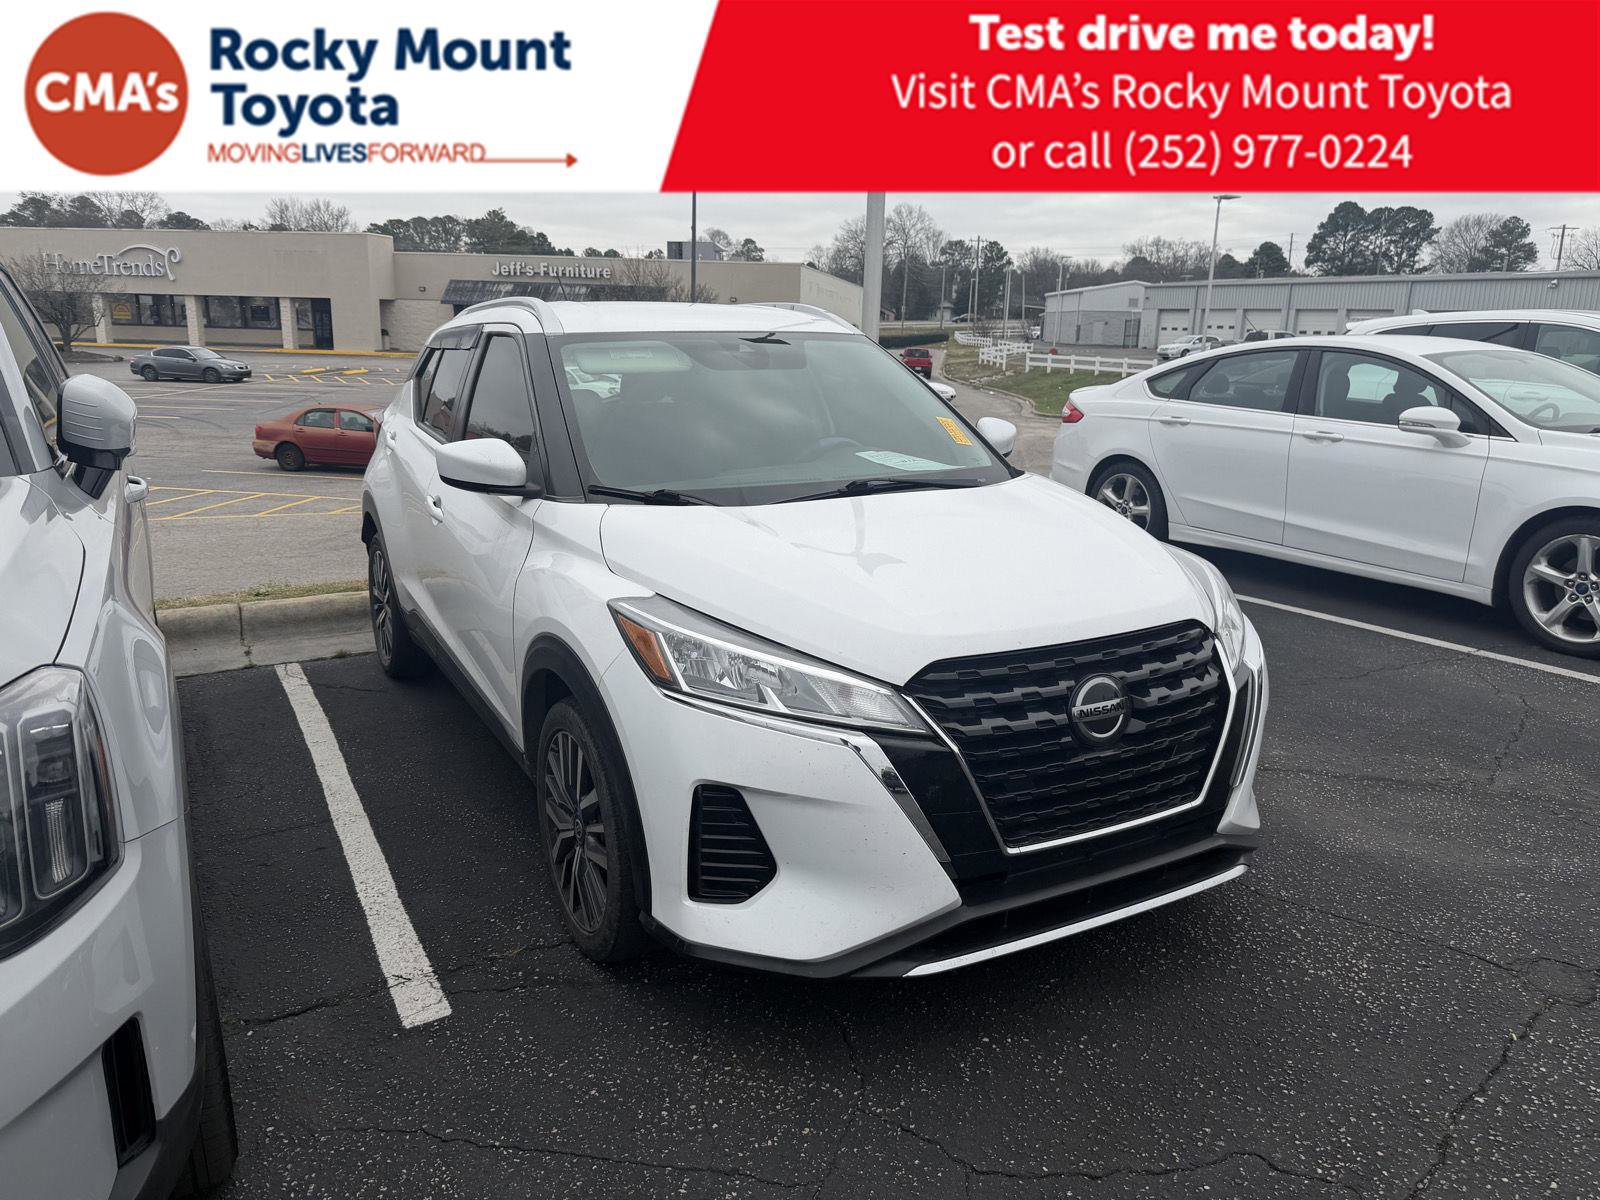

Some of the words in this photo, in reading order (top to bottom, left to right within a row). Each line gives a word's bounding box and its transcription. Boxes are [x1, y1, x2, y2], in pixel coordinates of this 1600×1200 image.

[491, 261, 534, 277] Jeff's
[540, 263, 611, 279] Furniture
[1079, 702, 1125, 717] NISSAN
